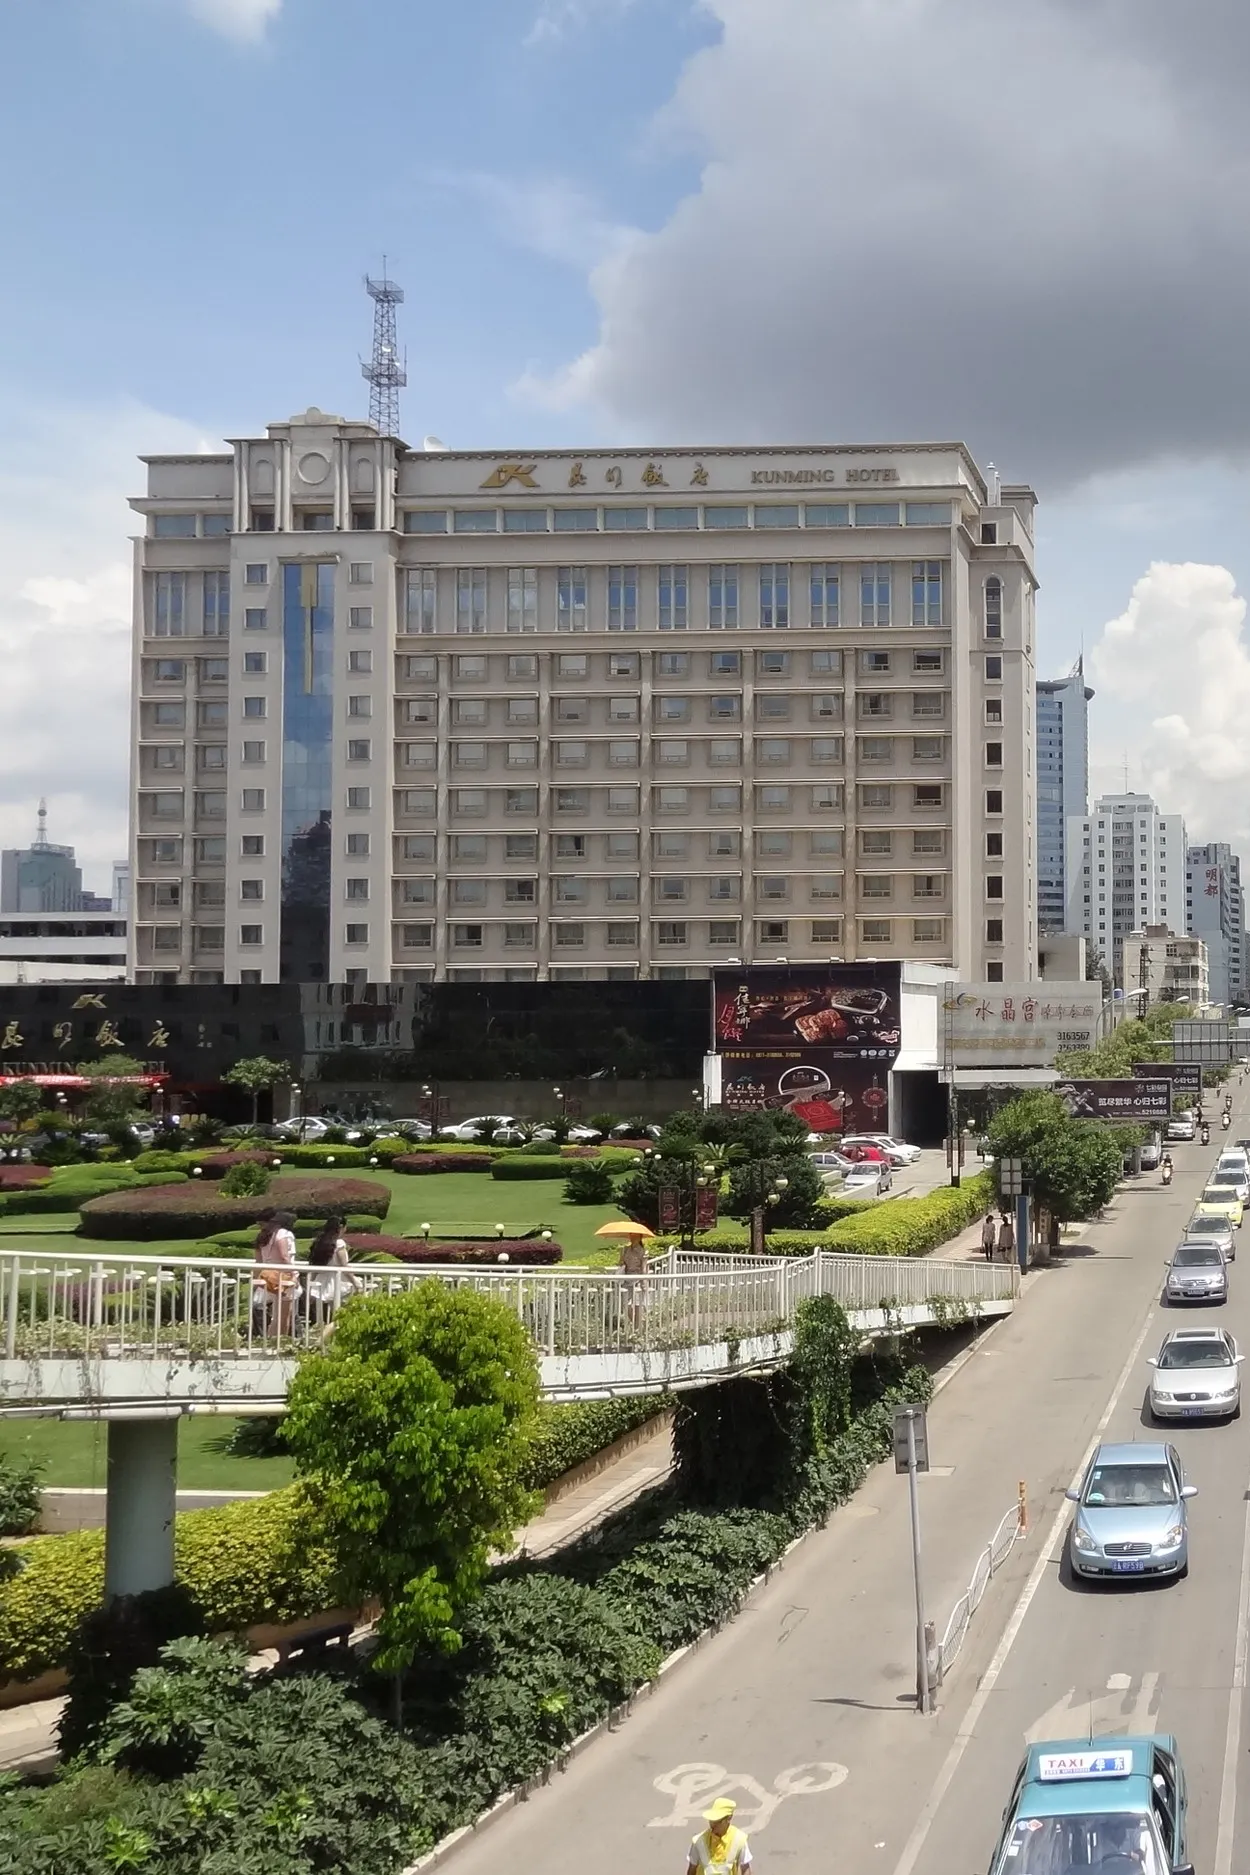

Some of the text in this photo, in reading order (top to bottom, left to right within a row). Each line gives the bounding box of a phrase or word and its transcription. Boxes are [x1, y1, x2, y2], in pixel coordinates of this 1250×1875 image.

[750, 468, 900, 484] KUNMING HOTEL
[1204, 868, 1218, 898] 明都
[975, 996, 1039, 1022] 水晶宫
[1057, 1031, 1090, 1041] 3163567
[1048, 1758, 1084, 1769] TAXI
